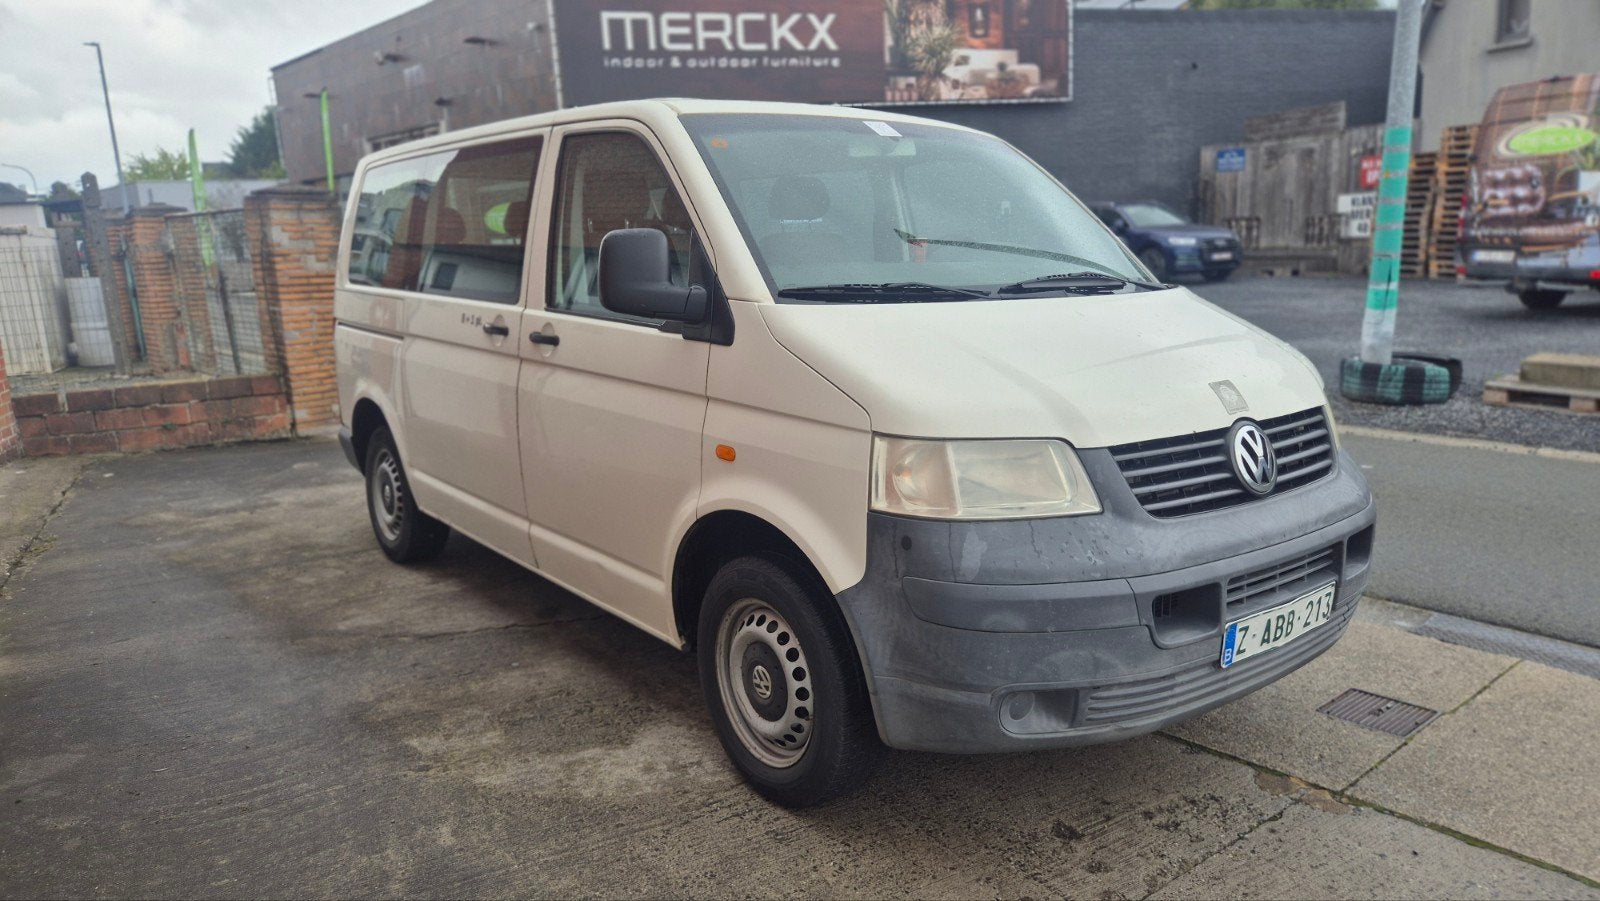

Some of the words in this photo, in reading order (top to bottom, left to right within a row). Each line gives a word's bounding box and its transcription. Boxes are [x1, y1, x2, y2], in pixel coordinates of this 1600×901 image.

[601, 11, 839, 51] MERCKX
[604, 55, 664, 68] indoor
[670, 55, 682, 68] &
[686, 55, 758, 68] outdoor
[762, 55, 841, 68] furniture
[1224, 648, 1232, 662] B
